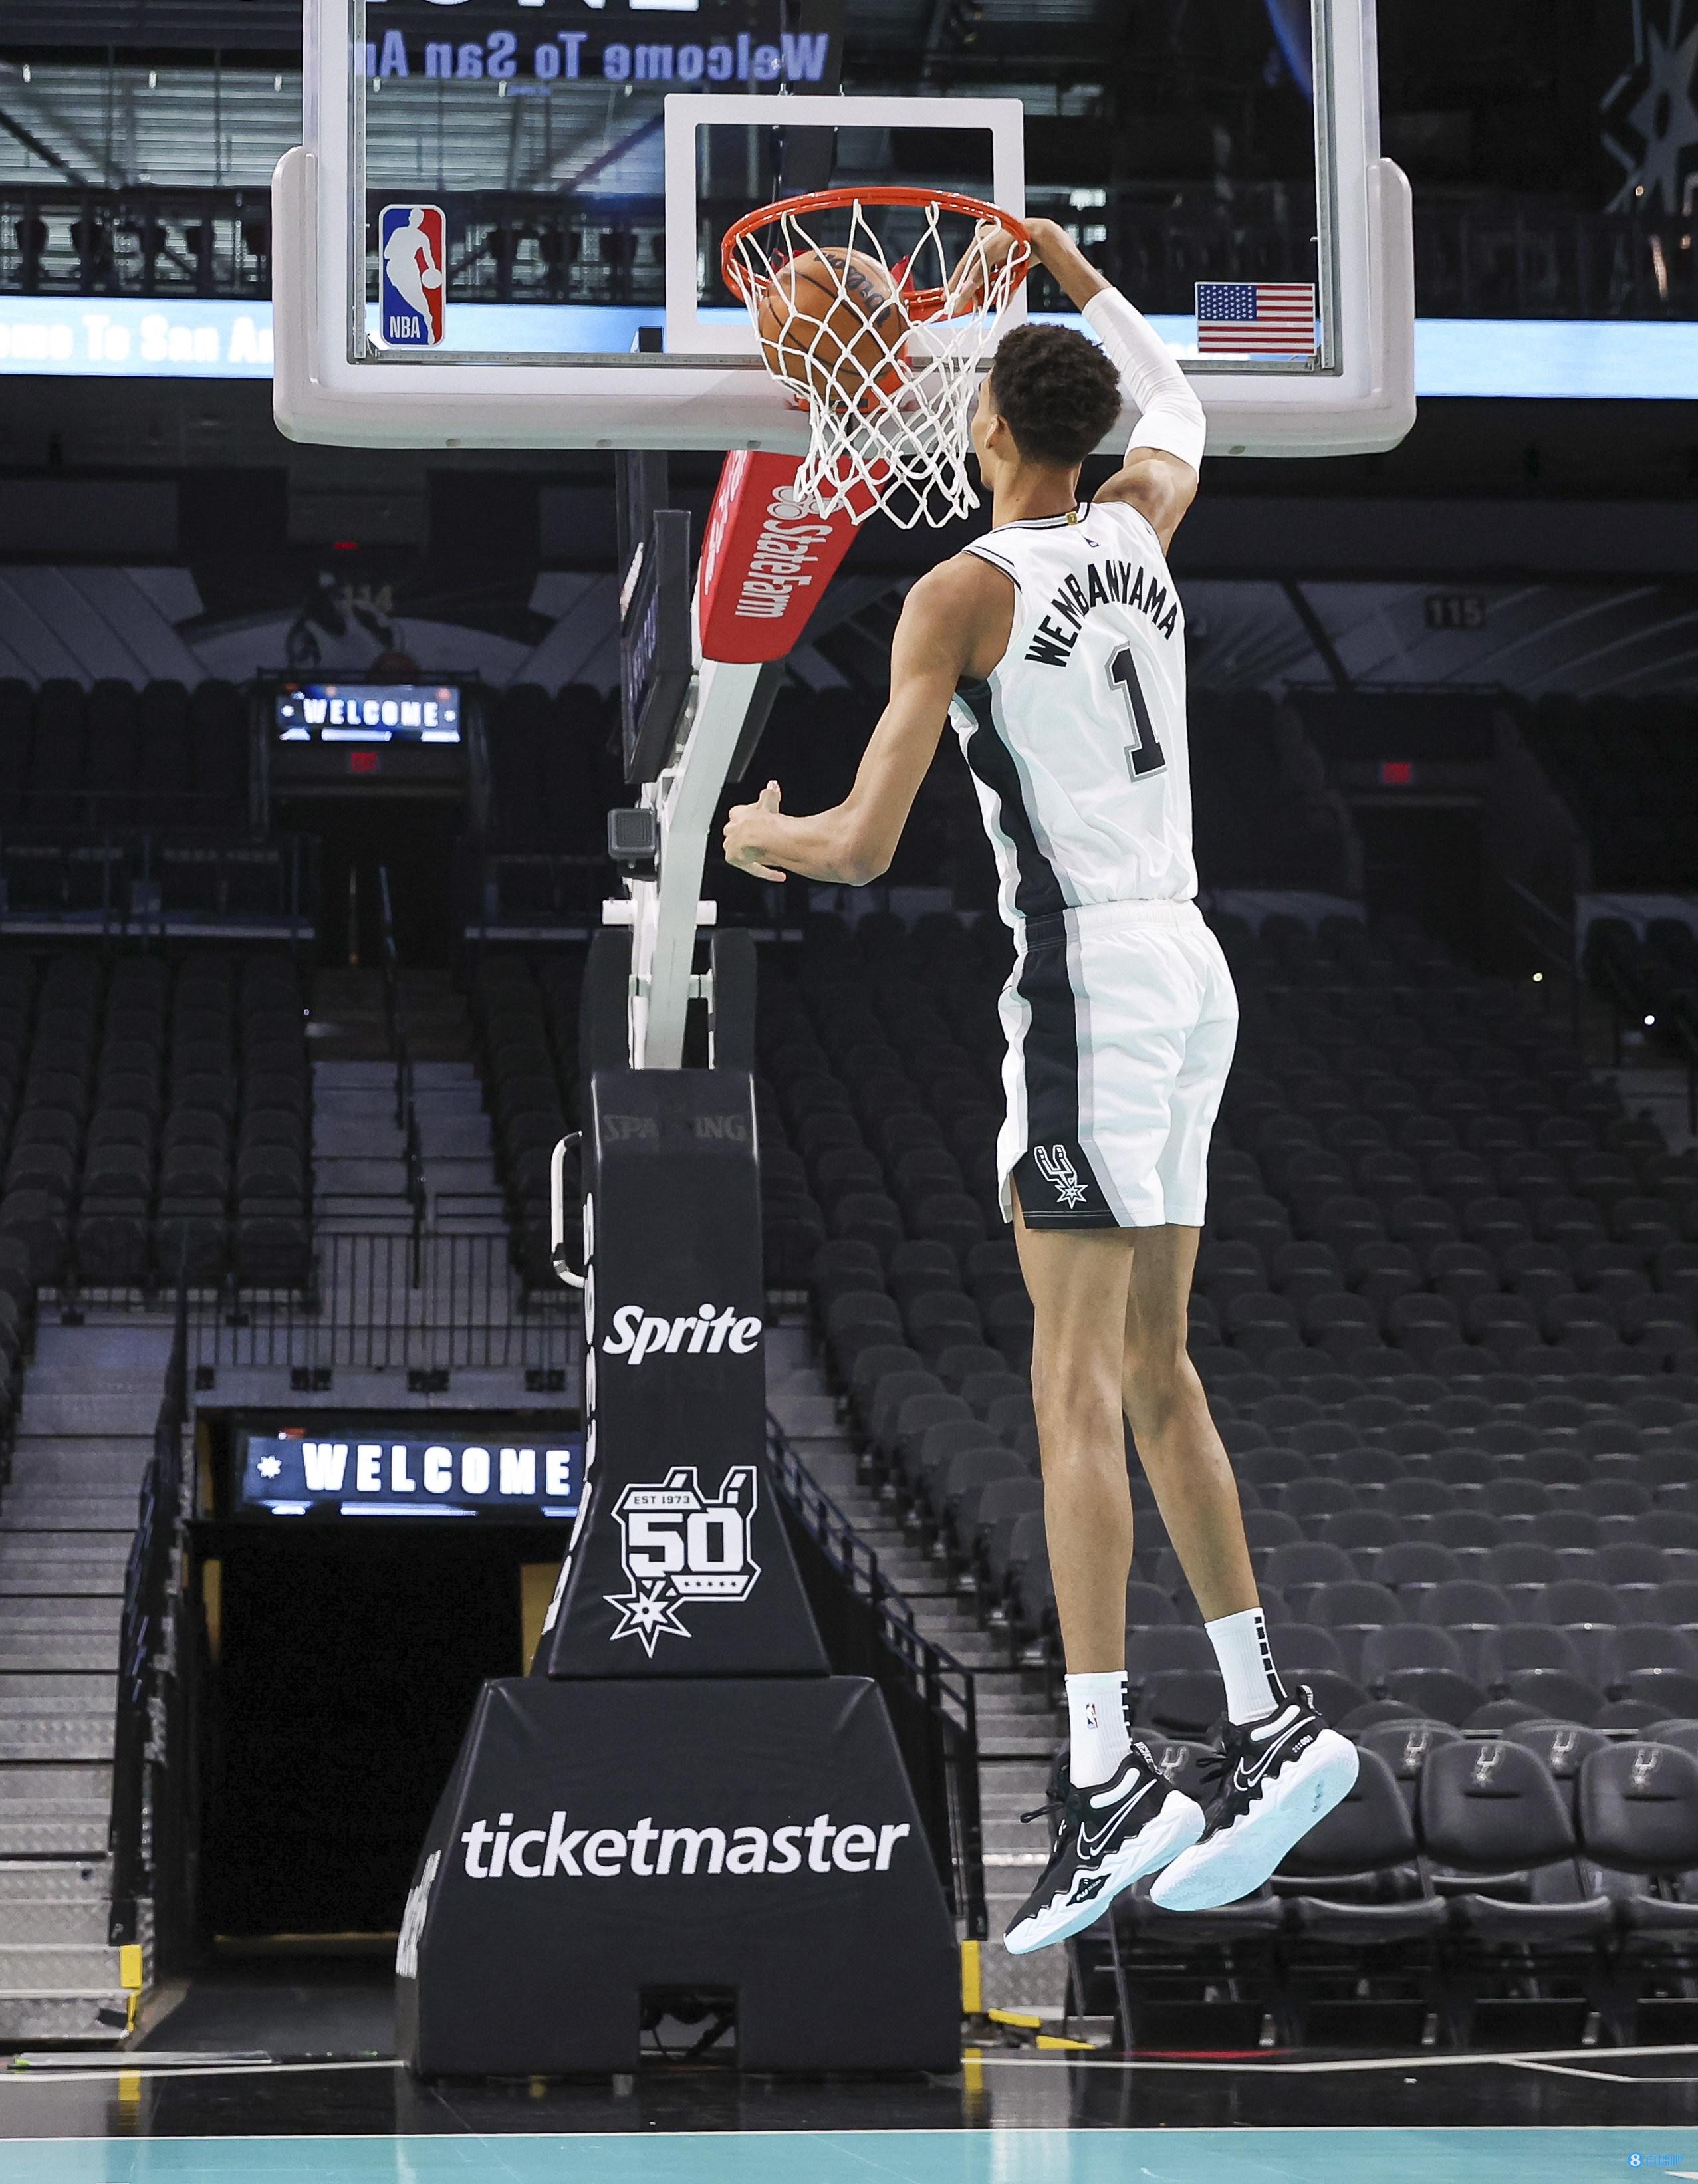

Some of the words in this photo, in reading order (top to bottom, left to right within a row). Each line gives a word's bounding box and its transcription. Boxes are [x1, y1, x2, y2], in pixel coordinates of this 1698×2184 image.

[390, 316, 420, 338] NBA
[1024, 559, 1178, 667] WEMBANYAMA
[303, 698, 439, 727] WELCOME
[1105, 642, 1167, 783] 1
[602, 1303, 763, 1365] Sprite
[302, 1443, 571, 1496] WELCOME
[633, 1495, 656, 1505] EST
[662, 1495, 690, 1504] 1973
[628, 1507, 744, 1578] 50
[461, 1811, 910, 1878] ticketmaster
